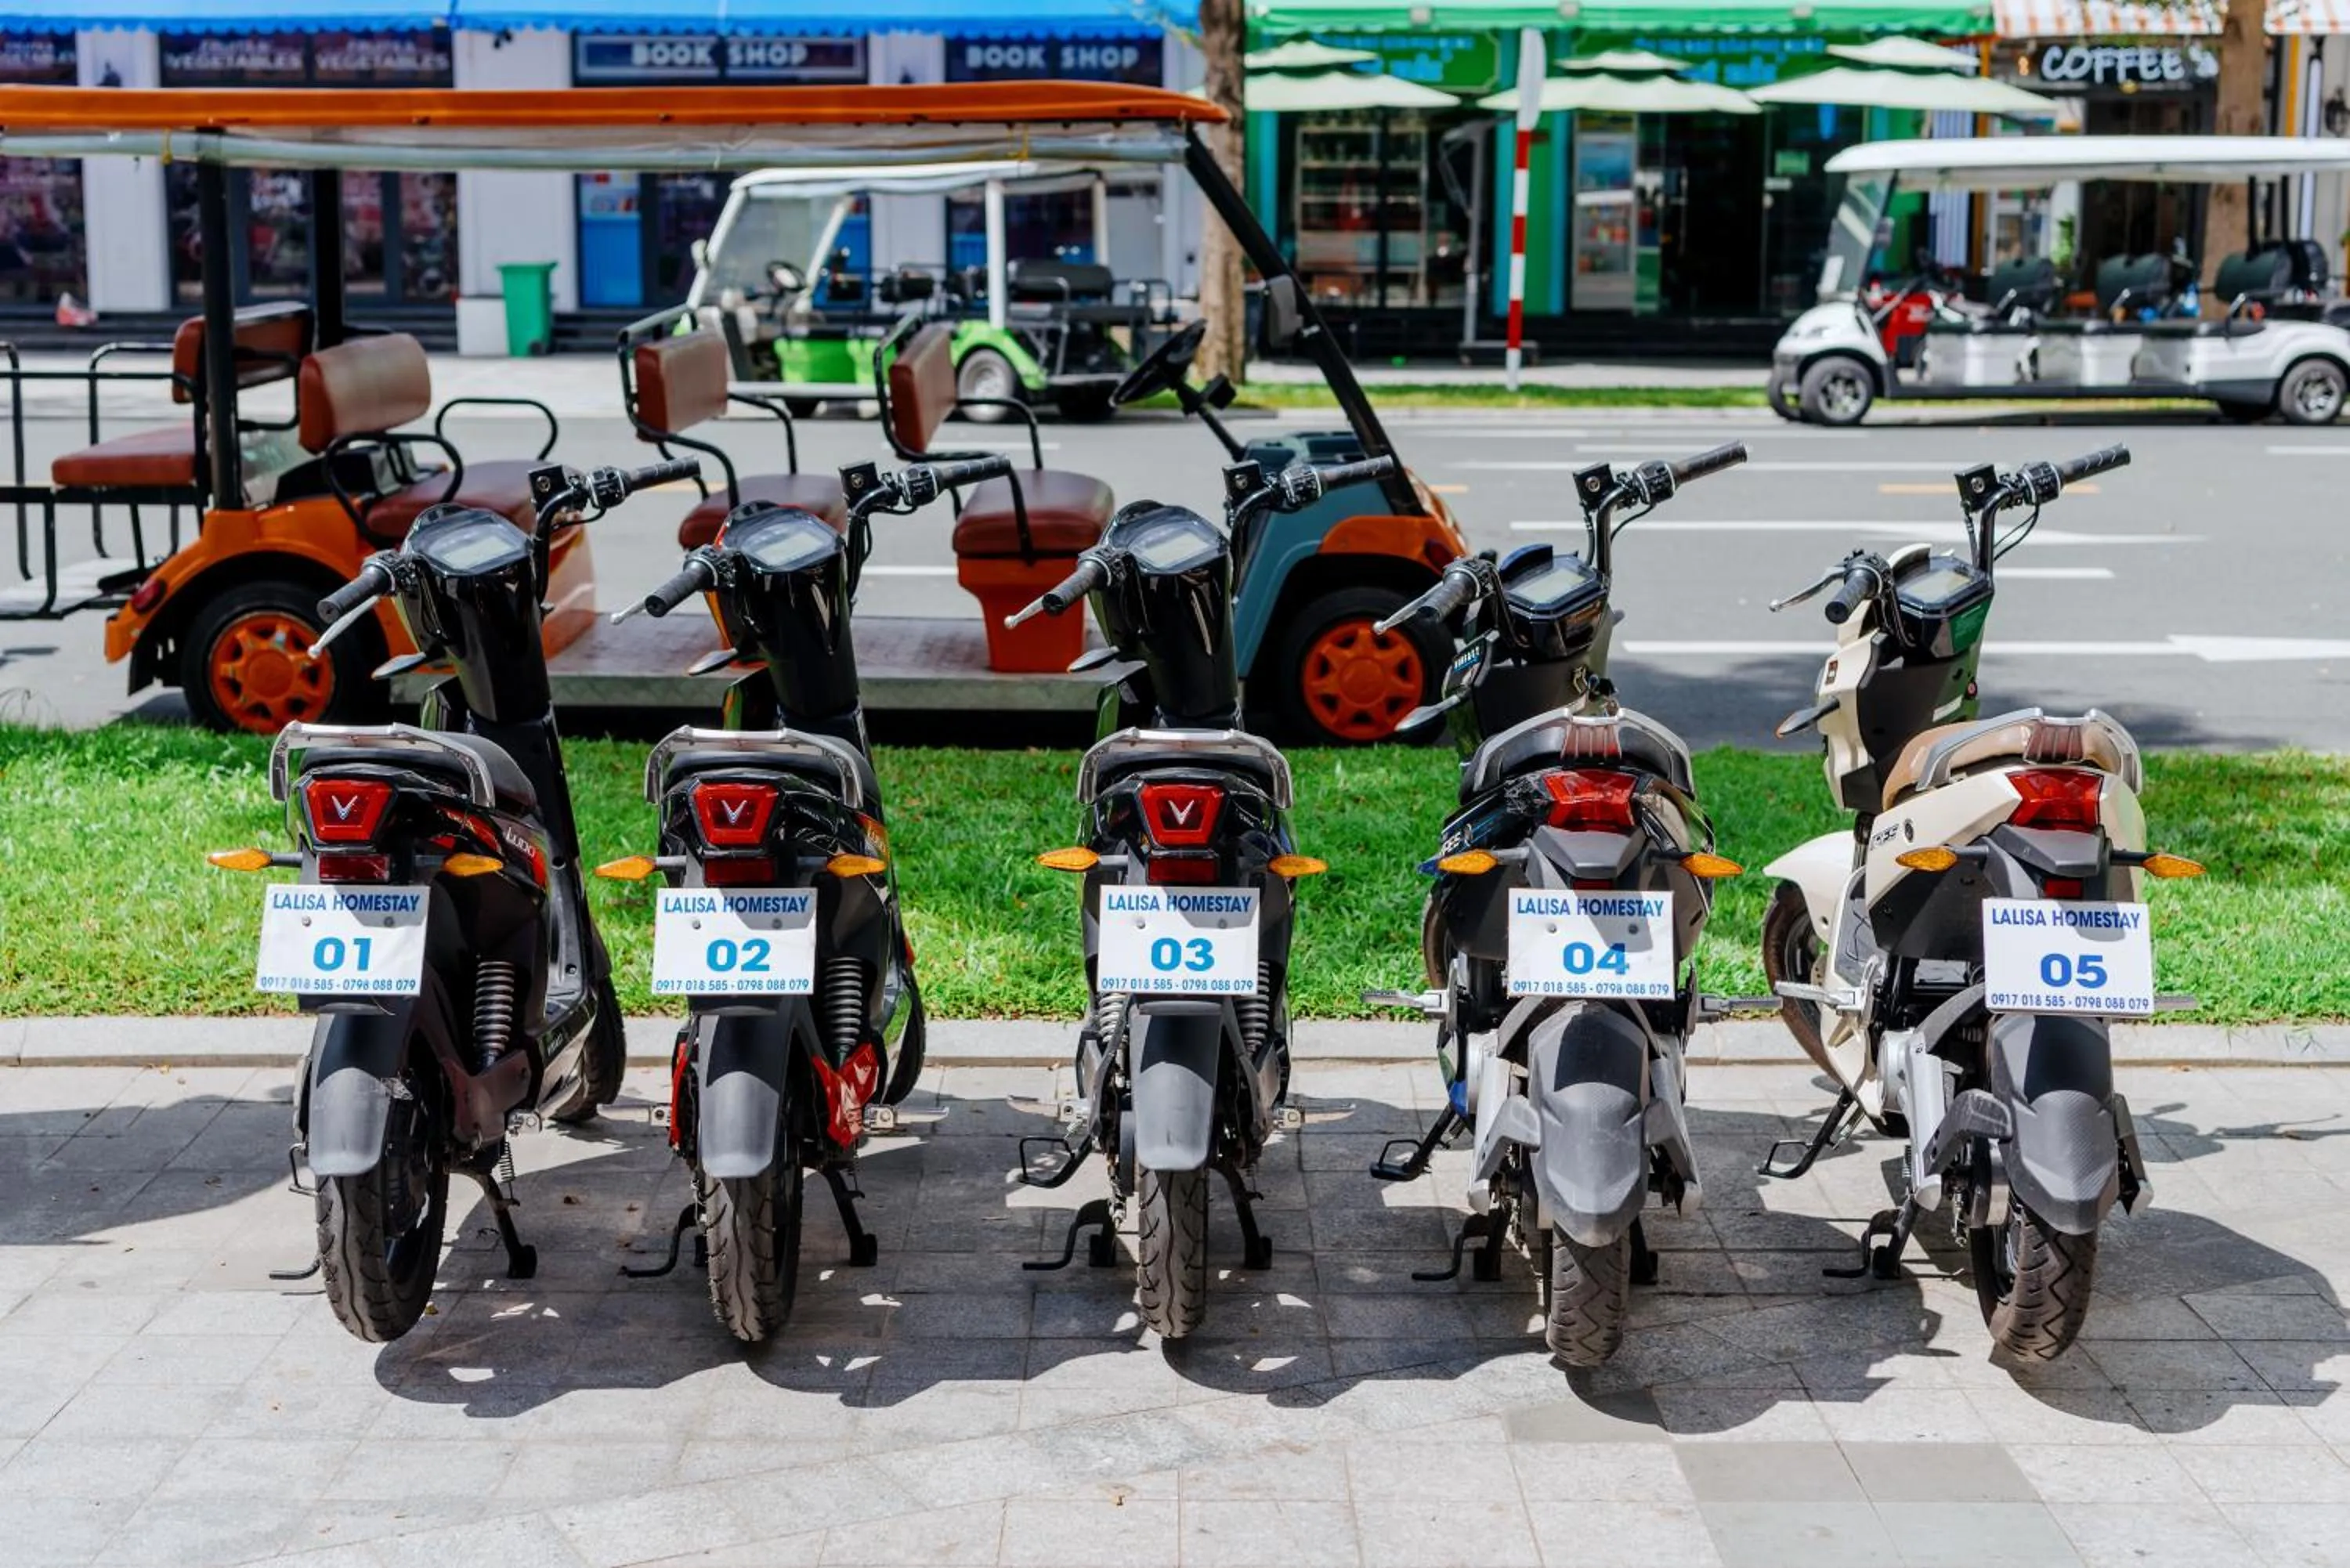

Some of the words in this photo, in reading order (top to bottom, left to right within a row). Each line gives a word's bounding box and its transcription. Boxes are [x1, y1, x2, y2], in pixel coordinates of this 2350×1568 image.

[631, 42, 710, 67] BOOK
[728, 42, 808, 66] SHOP
[965, 45, 1046, 68] BOOK
[1060, 46, 1140, 69] SHOP
[2041, 45, 2185, 83] COFFEE
[273, 894, 327, 910] LALISA
[333, 894, 420, 912] HOMESTAY
[664, 897, 716, 912] LALISA
[723, 897, 808, 912] HOMESTAY
[1108, 894, 1160, 911] LALISA
[1166, 895, 1252, 912] HOMESTAY
[1517, 898, 1570, 915] LALISA
[1577, 898, 1664, 916] HOMESTAY
[1992, 908, 2046, 926] LALISA
[2052, 910, 2140, 928] HOMESTAY
[313, 937, 372, 972] 01
[707, 938, 771, 972] 02
[1151, 938, 1214, 972] 03
[1563, 941, 1630, 975] 04
[2041, 953, 2108, 989] 05
[261, 977, 286, 988] 0917
[291, 977, 310, 989] 018
[314, 978, 333, 990] 585
[343, 979, 369, 990] 0798
[396, 980, 416, 991] 079
[656, 981, 682, 991] 0917
[685, 981, 704, 991] 018
[708, 980, 728, 991] 585
[737, 980, 763, 991] 0798
[789, 980, 809, 990] 079
[1101, 978, 1127, 989] 0917
[1130, 978, 1149, 989] 018
[1153, 979, 1173, 990] 585
[1182, 980, 1208, 991] 0798
[1234, 980, 1253, 991] 079
[1513, 981, 1539, 992] 0917
[1542, 981, 1564, 992] 018
[1567, 982, 1586, 993] 585
[1596, 983, 1622, 994] 0798
[1649, 984, 1669, 995] 079
[1991, 993, 2018, 1005] 0917
[2022, 994, 2042, 1006] 018
[2045, 995, 2065, 1006] 585
[2075, 996, 2102, 1008] 0798
[2128, 998, 2149, 1010] 079
